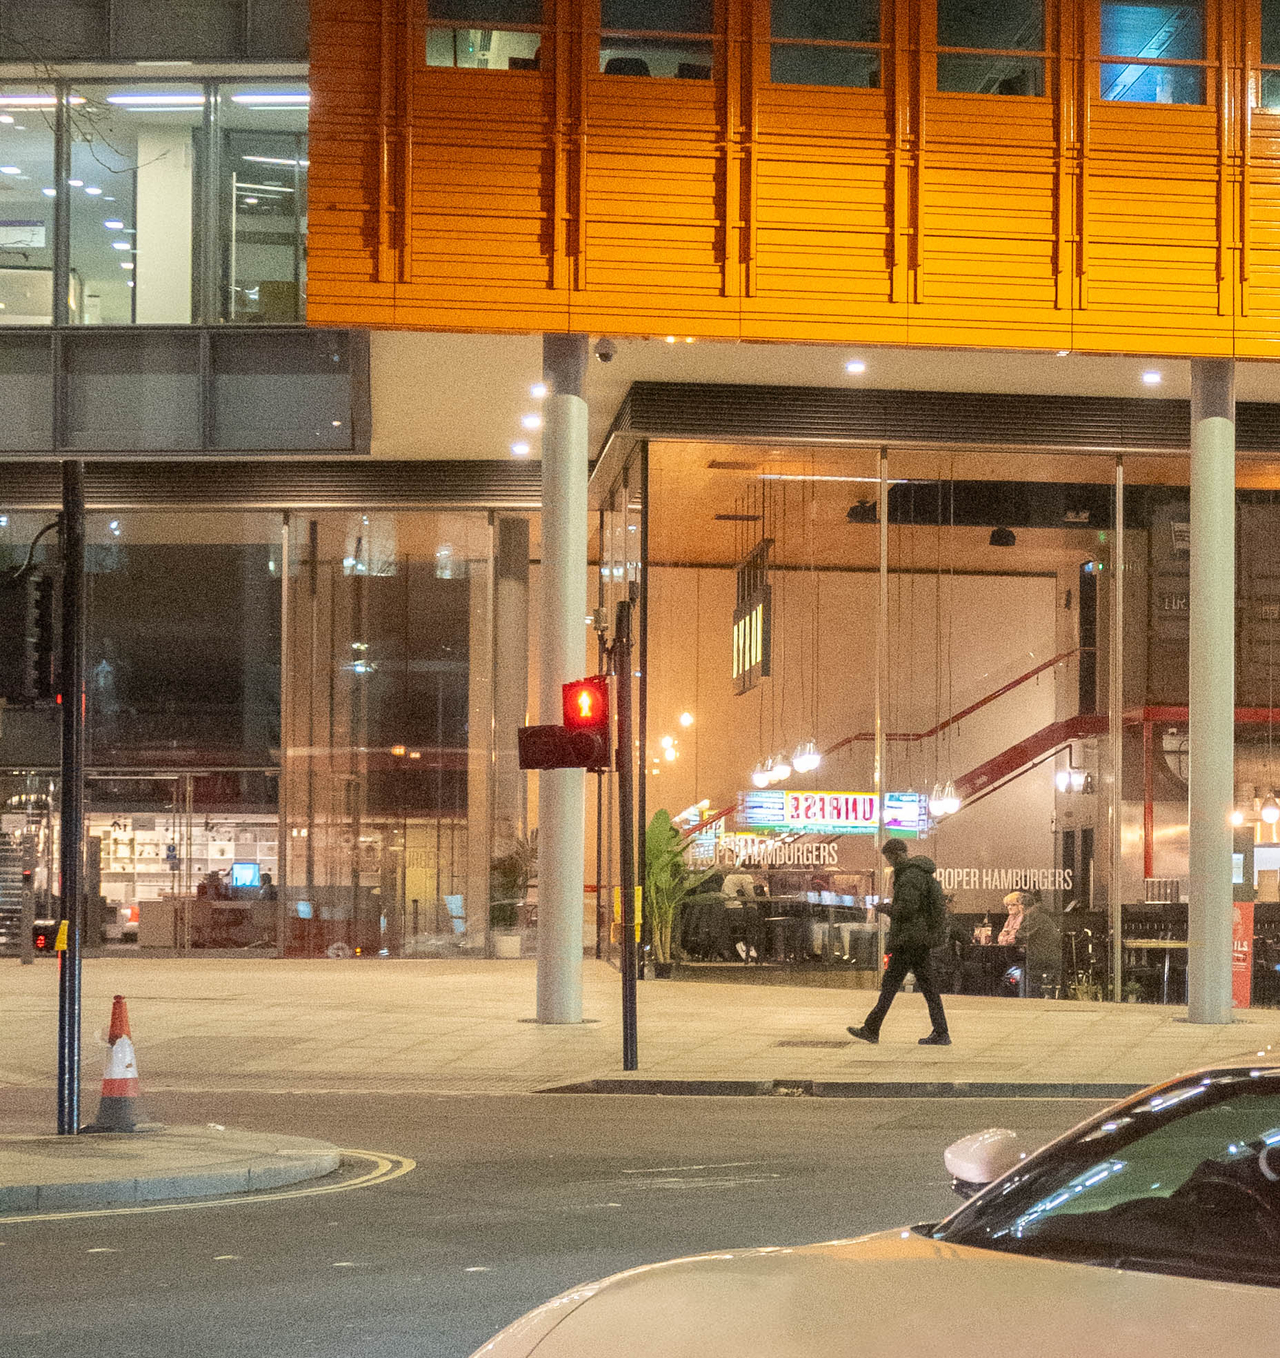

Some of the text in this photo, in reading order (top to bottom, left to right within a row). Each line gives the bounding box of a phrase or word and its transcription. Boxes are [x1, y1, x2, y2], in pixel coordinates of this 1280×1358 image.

[744, 843, 839, 865] HAMBURGERS
[932, 868, 1073, 891] ROPER HAMBURGERS
[1233, 941, 1249, 952] ILS
